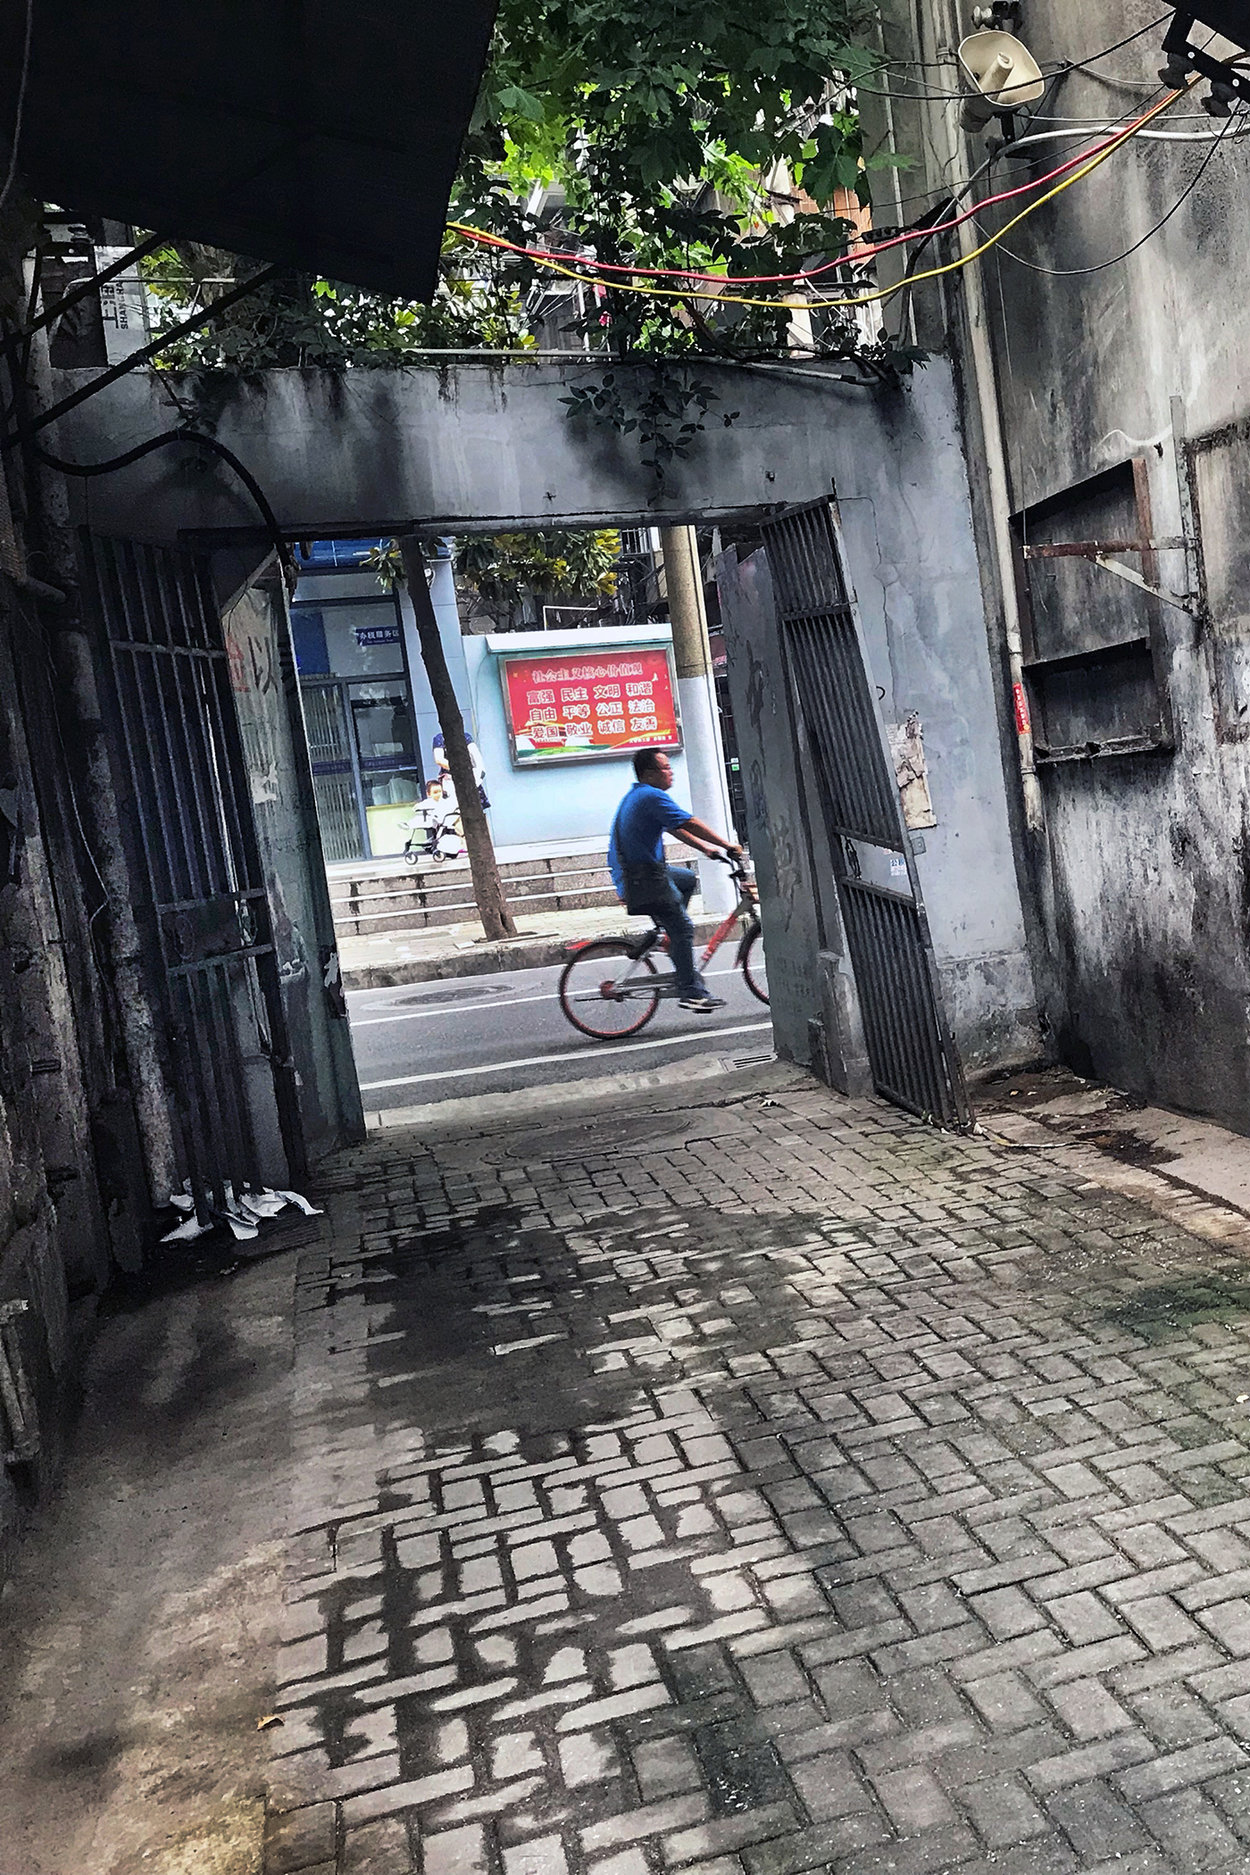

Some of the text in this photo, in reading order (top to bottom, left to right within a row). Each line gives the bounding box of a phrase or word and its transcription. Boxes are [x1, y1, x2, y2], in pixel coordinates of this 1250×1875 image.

[532, 663, 643, 683] 社会主义核心价值观
[527, 681, 653, 705] 富强 民主 文明 和谐
[528, 699, 655, 721] 自由 平等 公正 法治
[531, 717, 658, 739] 爱国 敬业 诚信 友善
